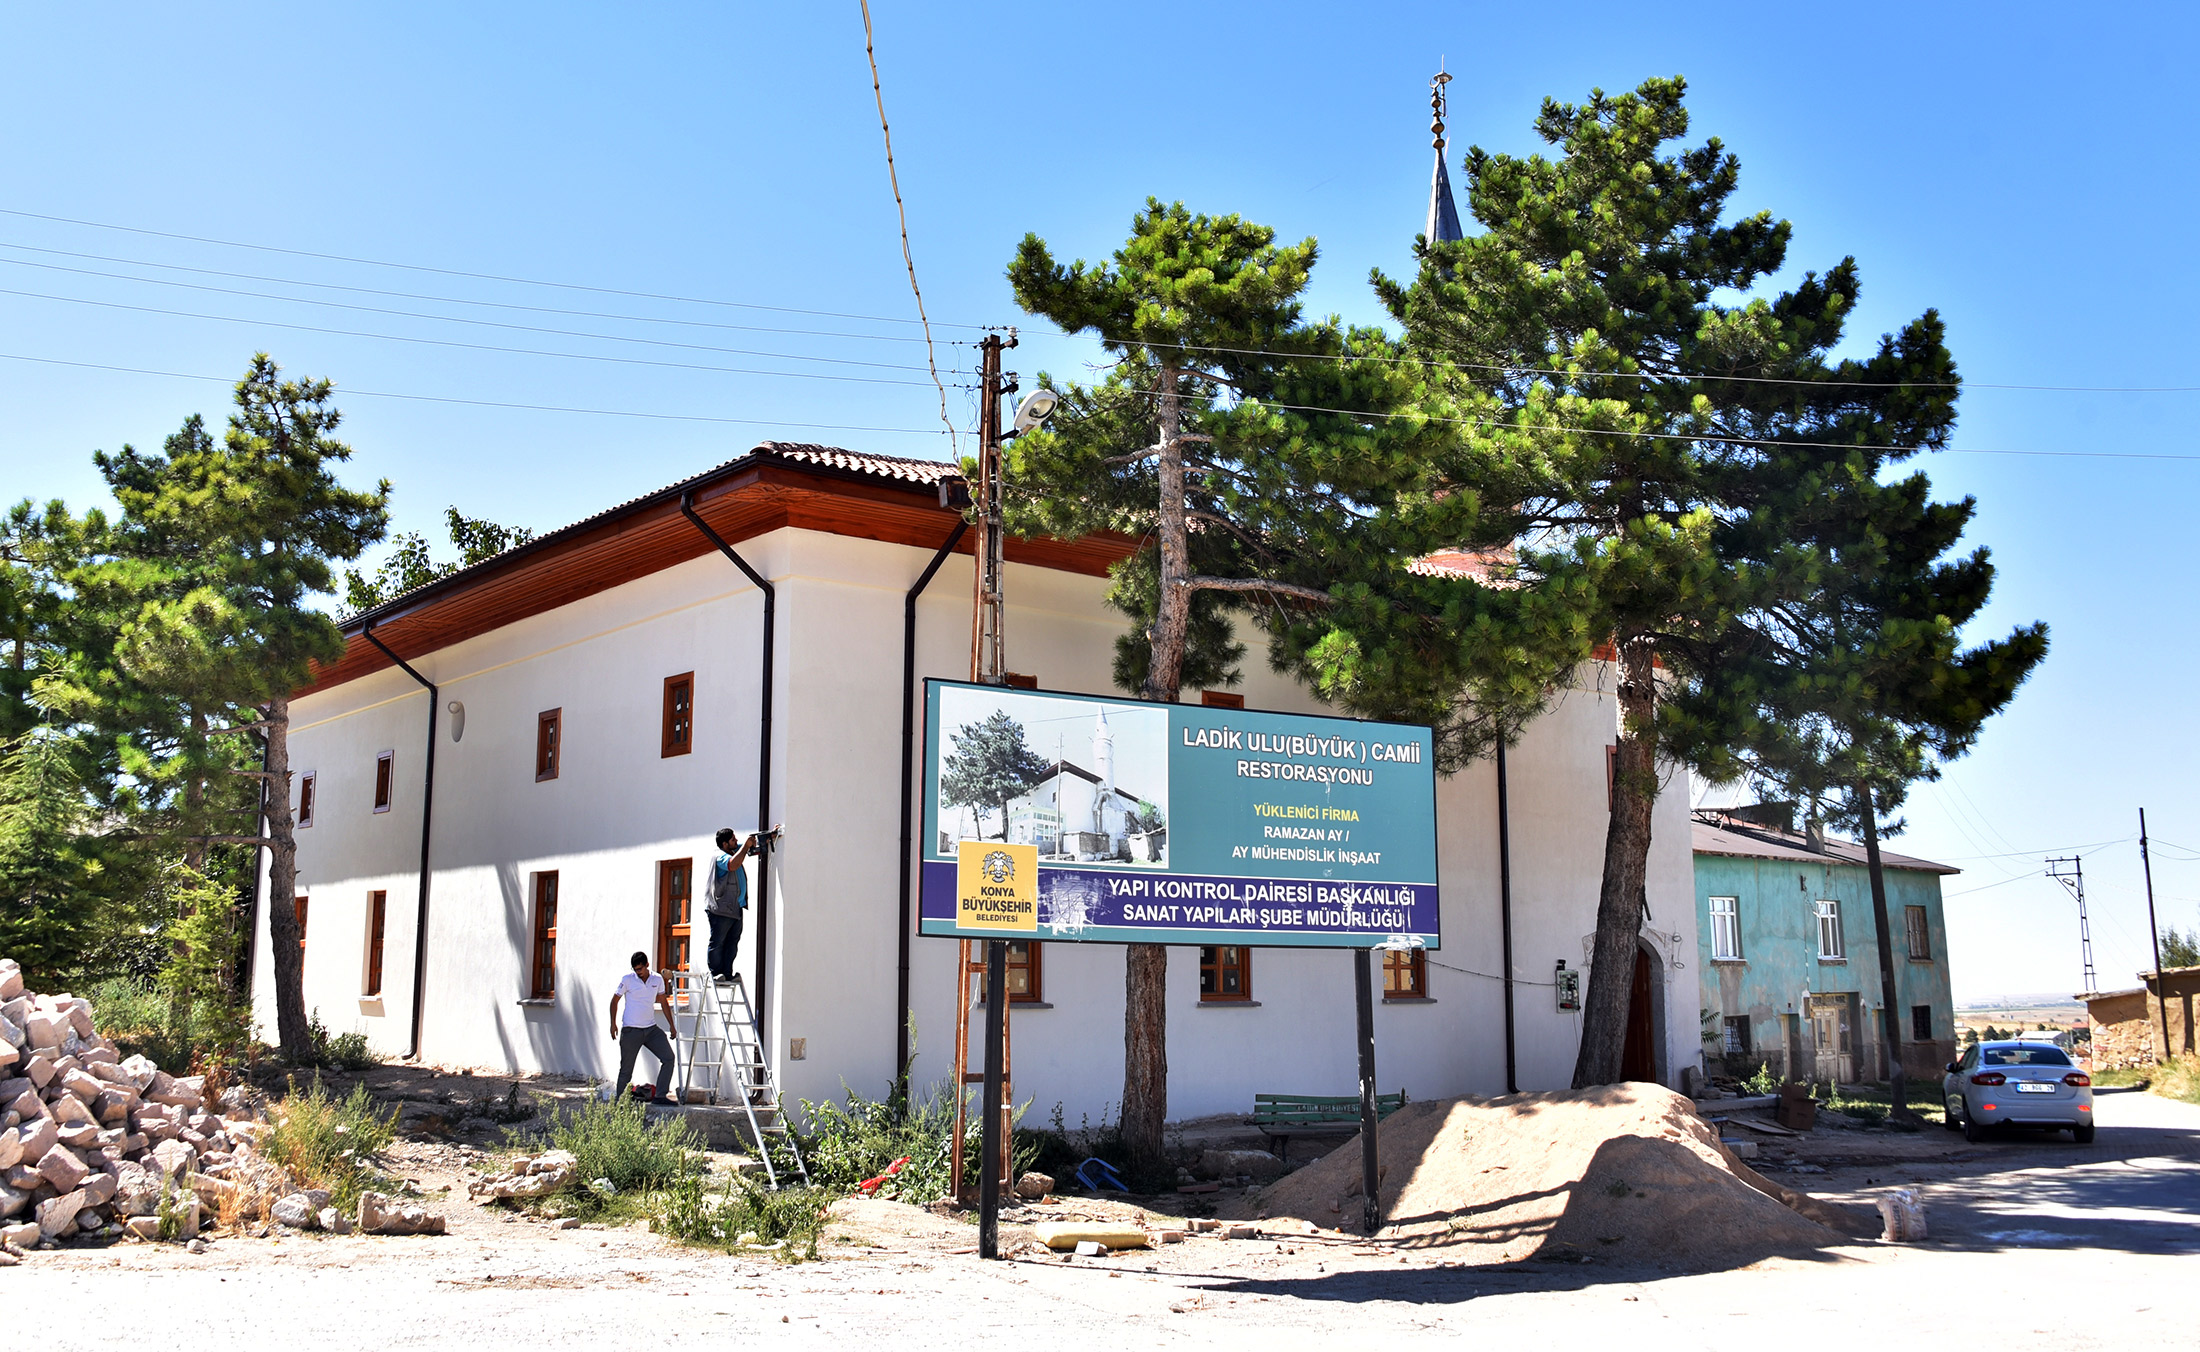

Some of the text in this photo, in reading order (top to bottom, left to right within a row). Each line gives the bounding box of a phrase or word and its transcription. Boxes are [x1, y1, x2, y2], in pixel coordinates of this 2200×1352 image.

[1183, 725, 1243, 752] LADİK
[1371, 742, 1421, 764] CAMİİ
[1236, 760, 1375, 786] RESTORASYONU
[1253, 802, 1360, 822] YÜKLENİCİ FİRMA
[1264, 825, 1326, 840] RAMAZAN
[1327, 828, 1343, 842] AY
[1232, 845, 1381, 867] AY MÜHENDİSLİK İNŞAAT
[980, 886, 1016, 898] KONYA
[1108, 878, 1416, 909] YAPI KONTROL DAİRESİ BAŞKANLIĞI
[962, 896, 1033, 914] BÜYÜKŞEHİR
[976, 913, 1018, 923] BELEDİYESİ
[1123, 903, 1405, 929] SANAT YAPILARI ŞUBE MÜDÜRLÜĞÜ
